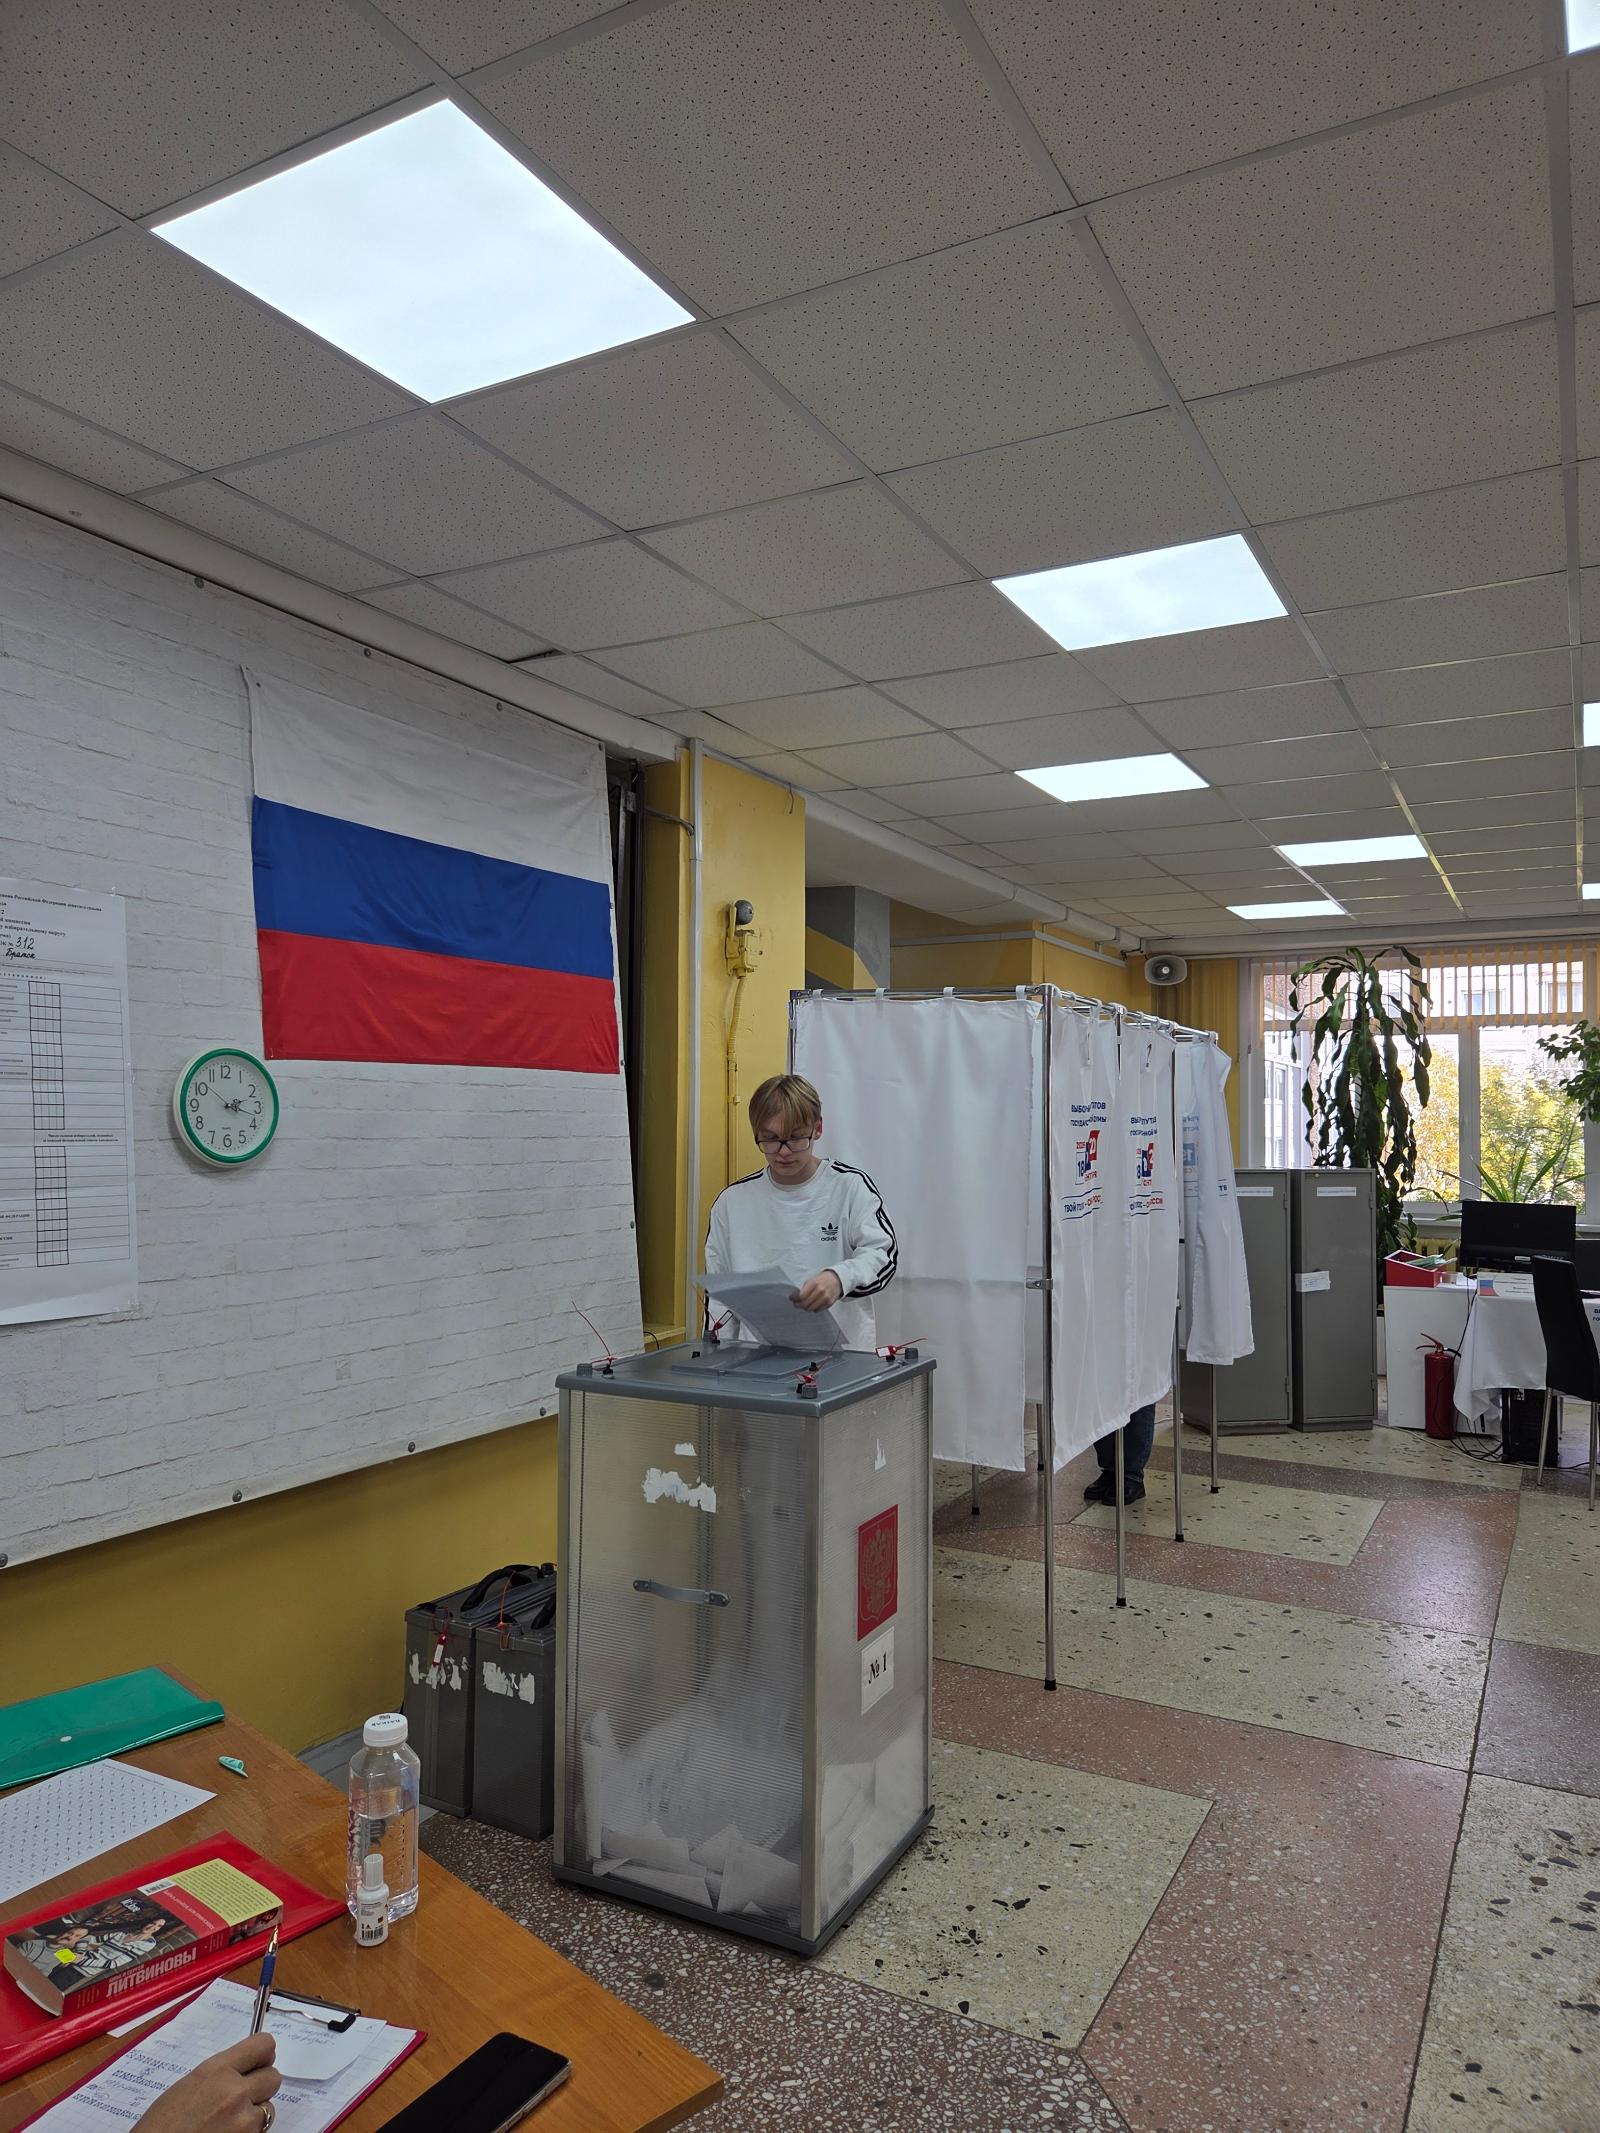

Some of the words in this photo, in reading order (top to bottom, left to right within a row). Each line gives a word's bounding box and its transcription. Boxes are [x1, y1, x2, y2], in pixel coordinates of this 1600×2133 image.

[15, 936, 35, 950] 312
[209, 1069, 215, 1083] 11
[220, 1065, 231, 1079] 12
[239, 1070, 242, 1083] 1
[195, 1082, 208, 1096] 10
[249, 1084, 256, 1098] 2
[190, 1098, 199, 1112] 9
[254, 1101, 262, 1114] 3
[195, 1116, 204, 1130] 8
[249, 1117, 257, 1130] 4
[208, 1130, 215, 1144] 7
[223, 1134, 232, 1147] 6
[238, 1130, 246, 1144] 5
[882, 1651, 887, 1673] 1
[106, 1946, 197, 1999] ЛИТВИНОВЫ
